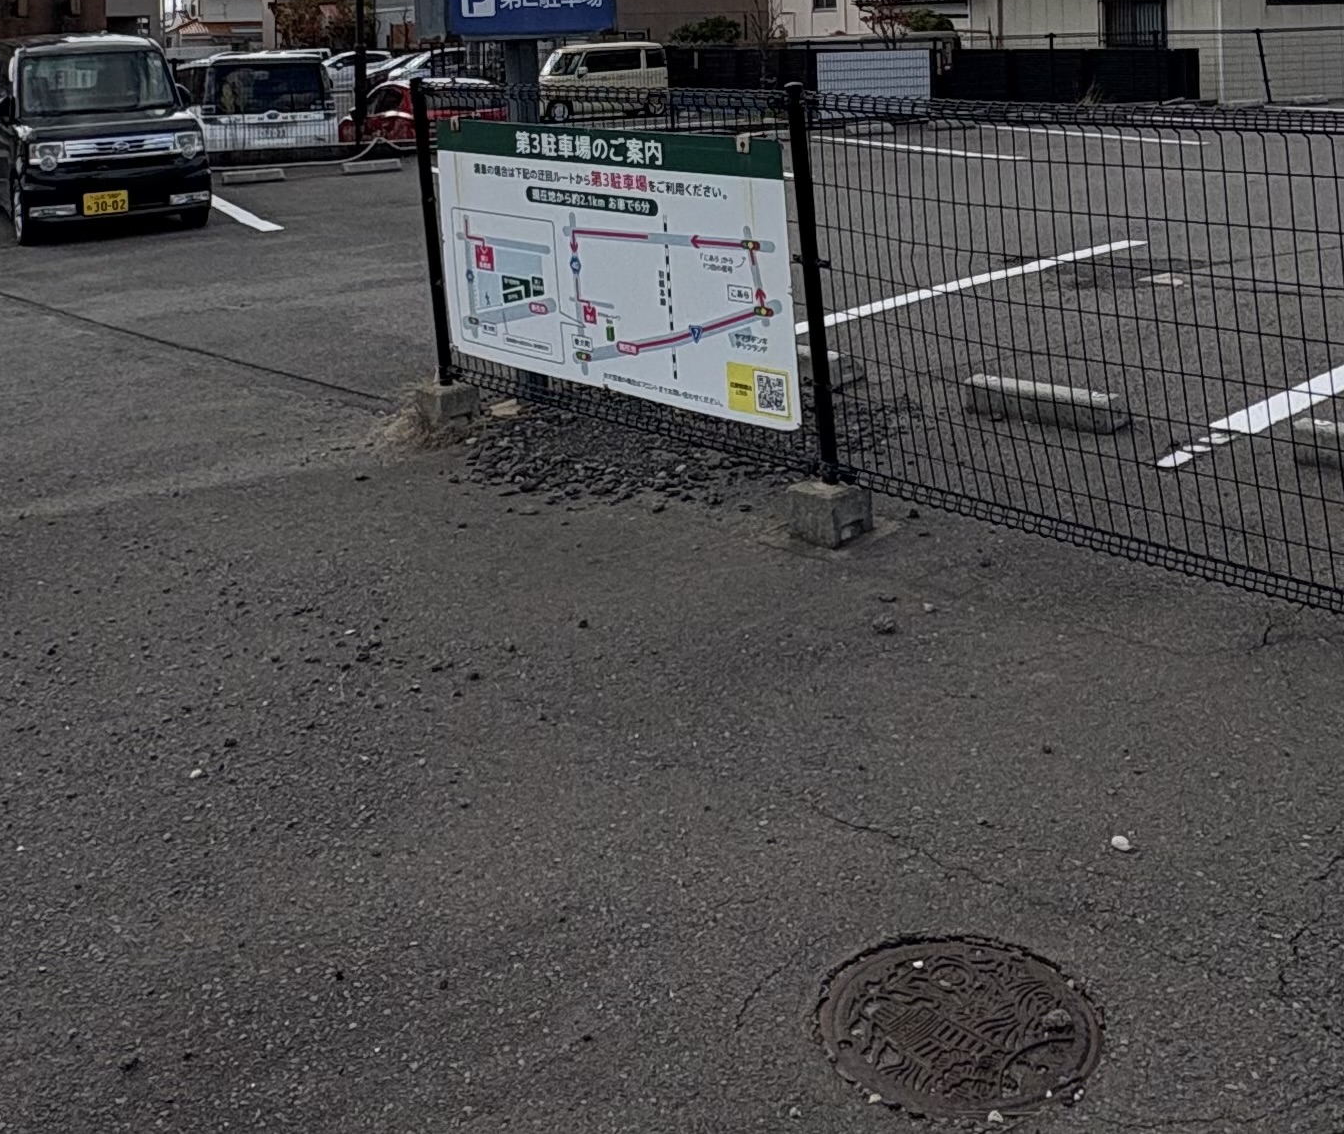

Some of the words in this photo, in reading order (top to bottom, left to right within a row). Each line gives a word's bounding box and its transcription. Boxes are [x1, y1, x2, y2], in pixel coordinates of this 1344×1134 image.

[514, 130, 664, 166] 第3駐車場のご案内
[93, 199, 126, 213] 30-02
